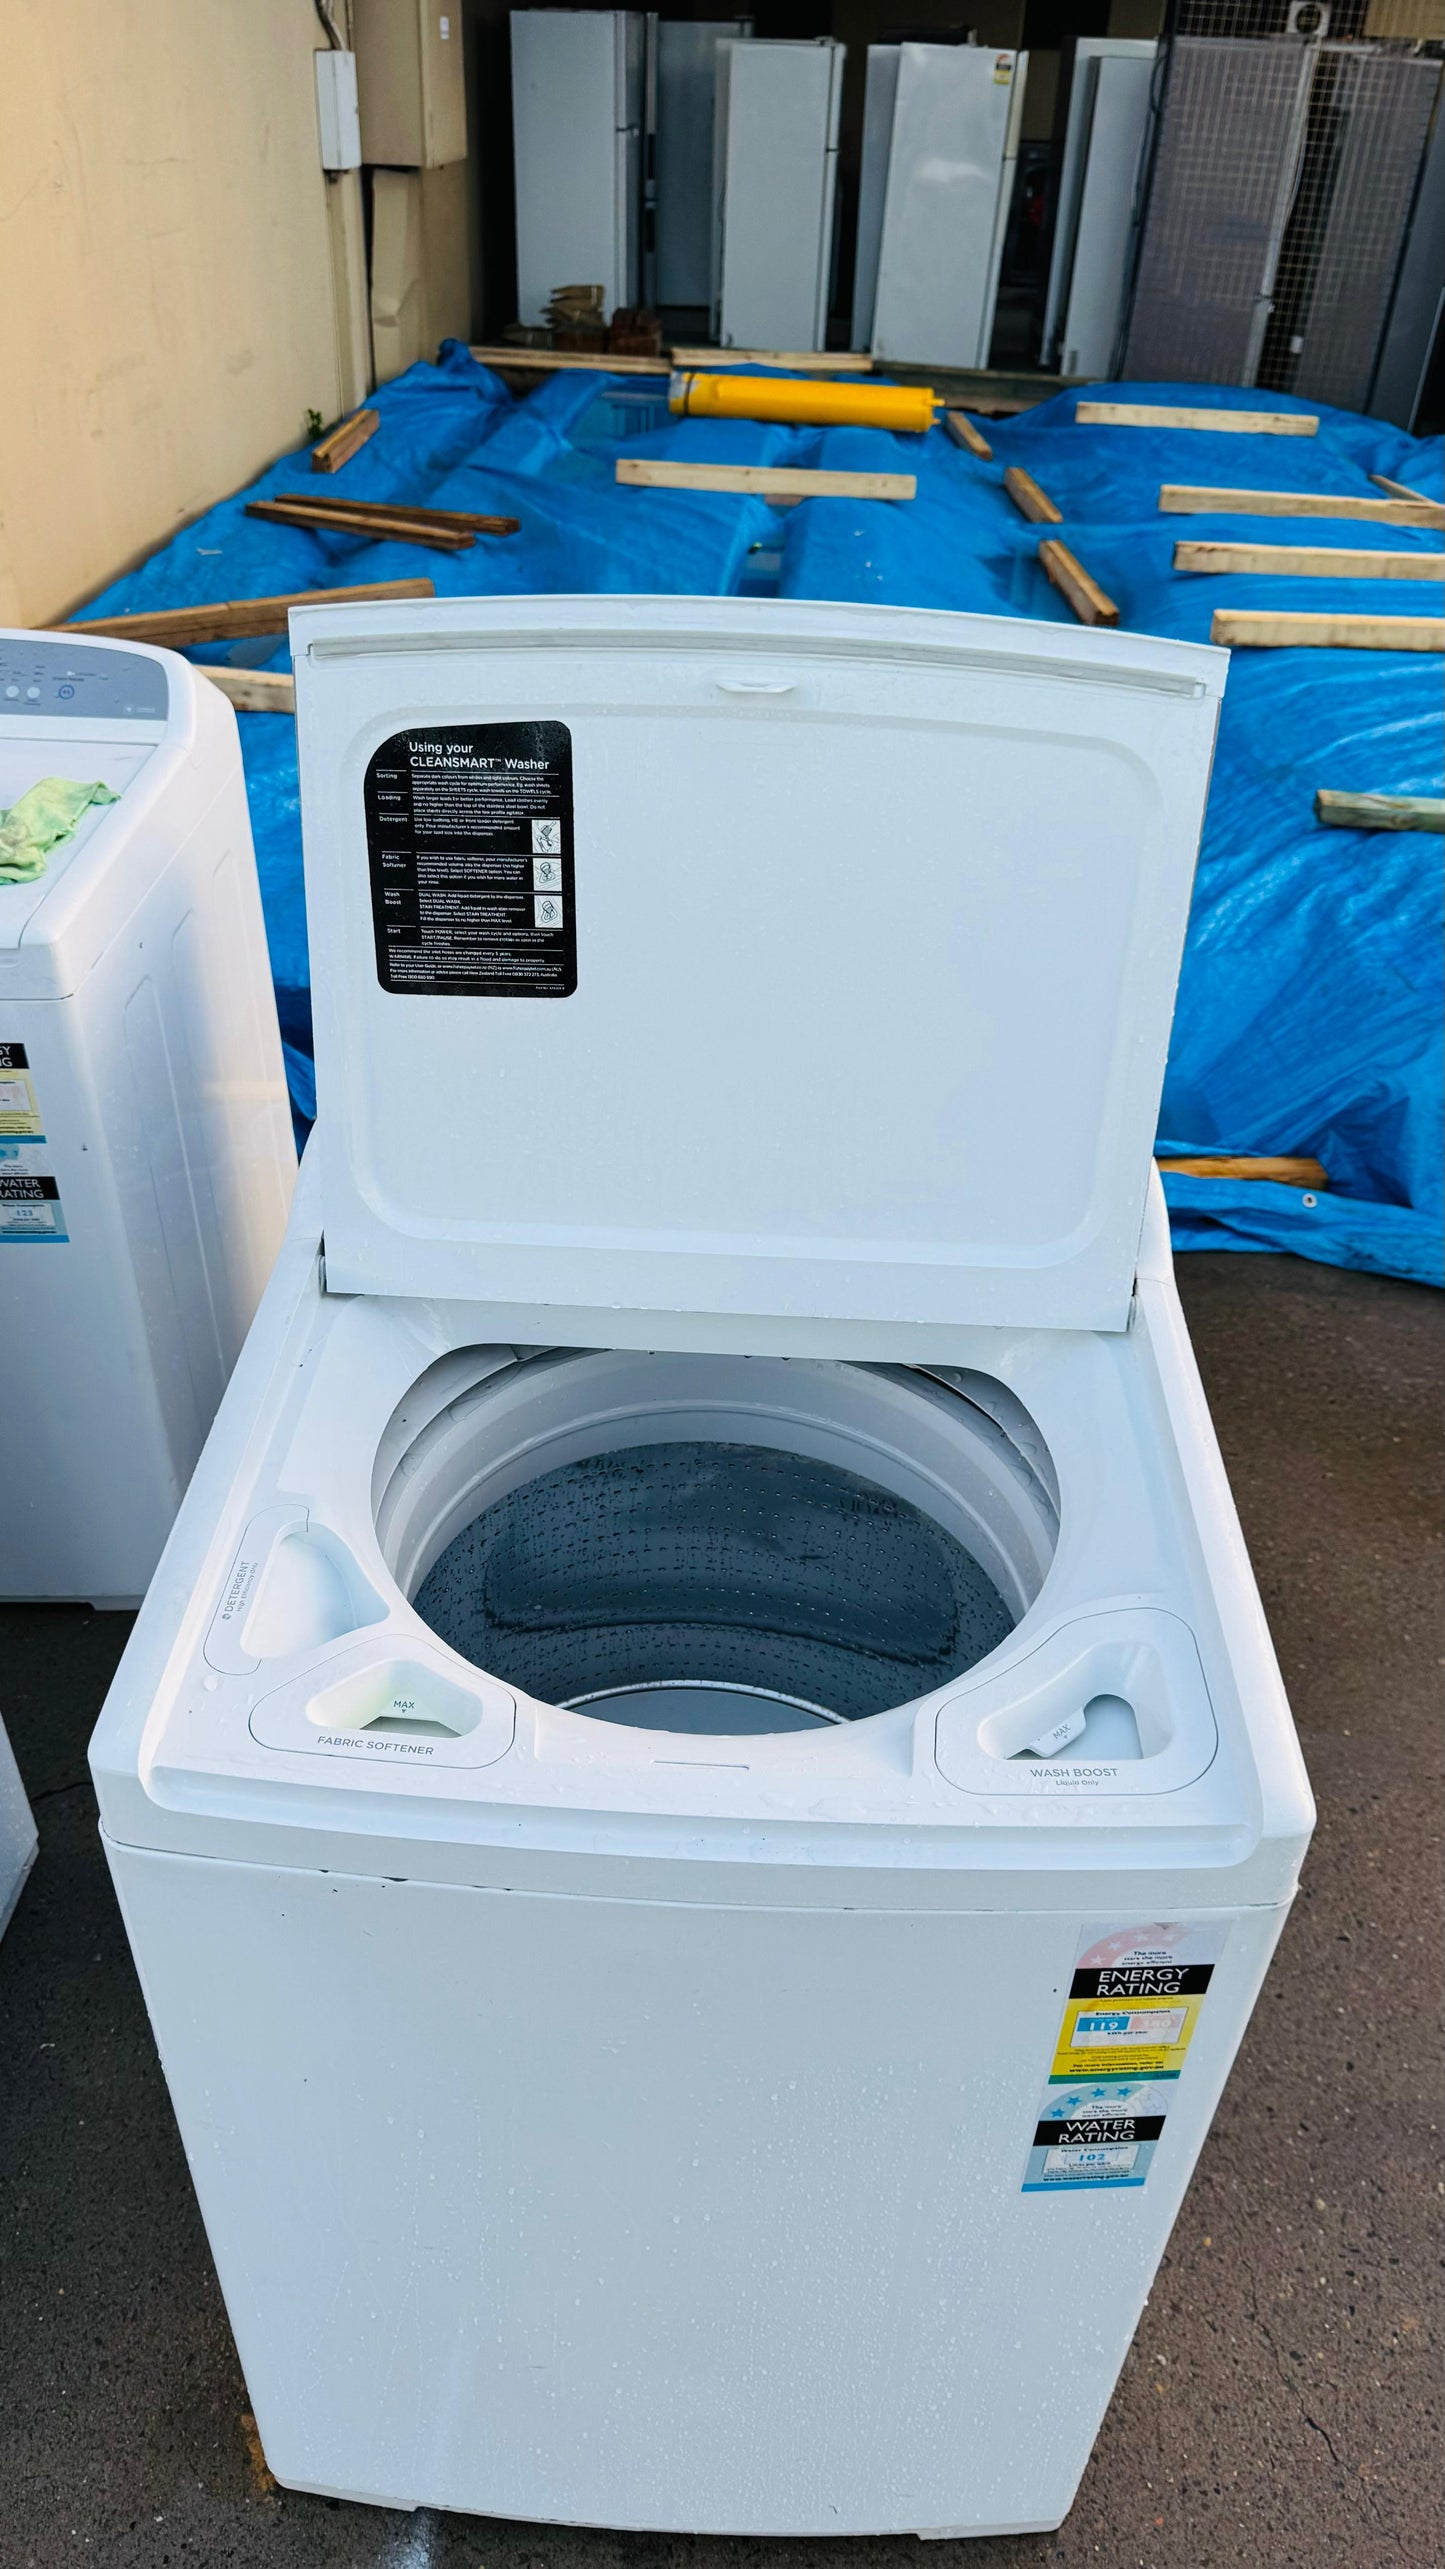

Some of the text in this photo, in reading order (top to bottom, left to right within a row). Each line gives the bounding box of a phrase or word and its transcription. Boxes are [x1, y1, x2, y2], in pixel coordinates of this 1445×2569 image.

[409, 741, 473, 755] Using your
[505, 758, 550, 769] Washer
[224, 1561, 249, 1611] DETERGENT
[393, 1700, 415, 1709] MAX
[1053, 1724, 1071, 1739] MAX
[317, 1735, 434, 1756] FABRIC SOFTENER
[1030, 1768, 1118, 1777] WASH BOOST
[1099, 1968, 1189, 1982] ENERGY
[1096, 1982, 1181, 1996] RATING
[1089, 2022, 1119, 2031] 119
[1066, 2119, 1136, 2132] WATER
[1058, 2131, 1135, 2144] RATING
[1078, 2153, 1106, 2161] 102
